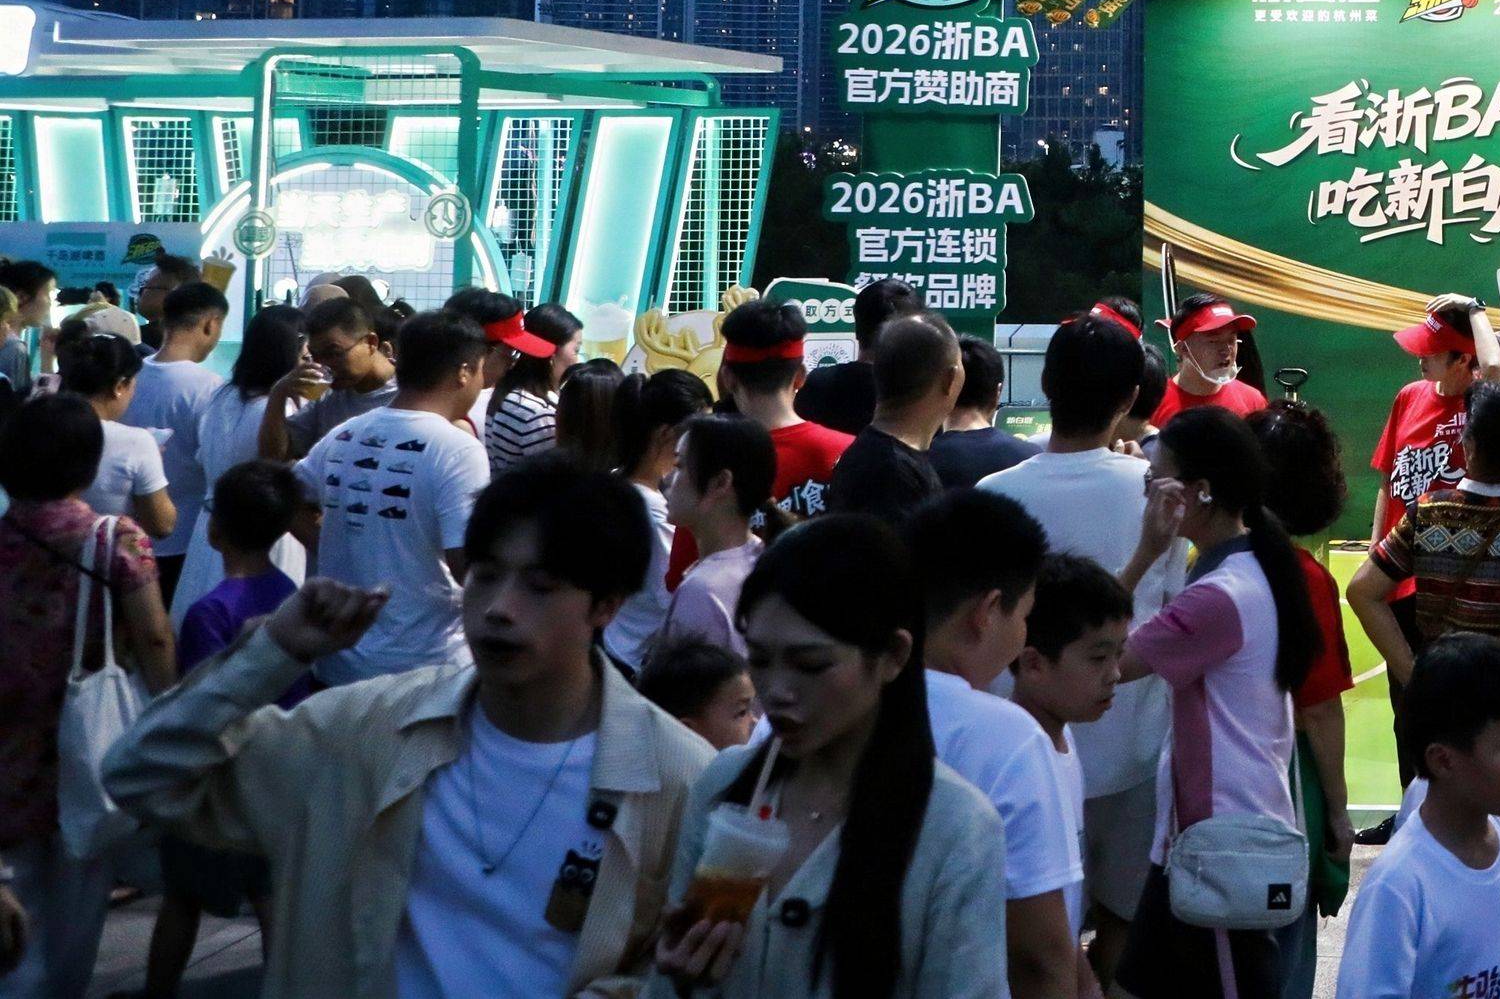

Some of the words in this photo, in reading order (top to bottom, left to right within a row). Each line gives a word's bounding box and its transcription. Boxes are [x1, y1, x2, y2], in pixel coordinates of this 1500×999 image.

[1254, 9, 1379, 22] 更受欢迎的杭州菜
[837, 21, 1029, 61] 2026浙BA
[844, 69, 1020, 107] 官方赞助商
[830, 178, 1024, 218] 2026浙BA
[855, 227, 998, 265] 官方连锁
[1390, 441, 1452, 481] 看浙B
